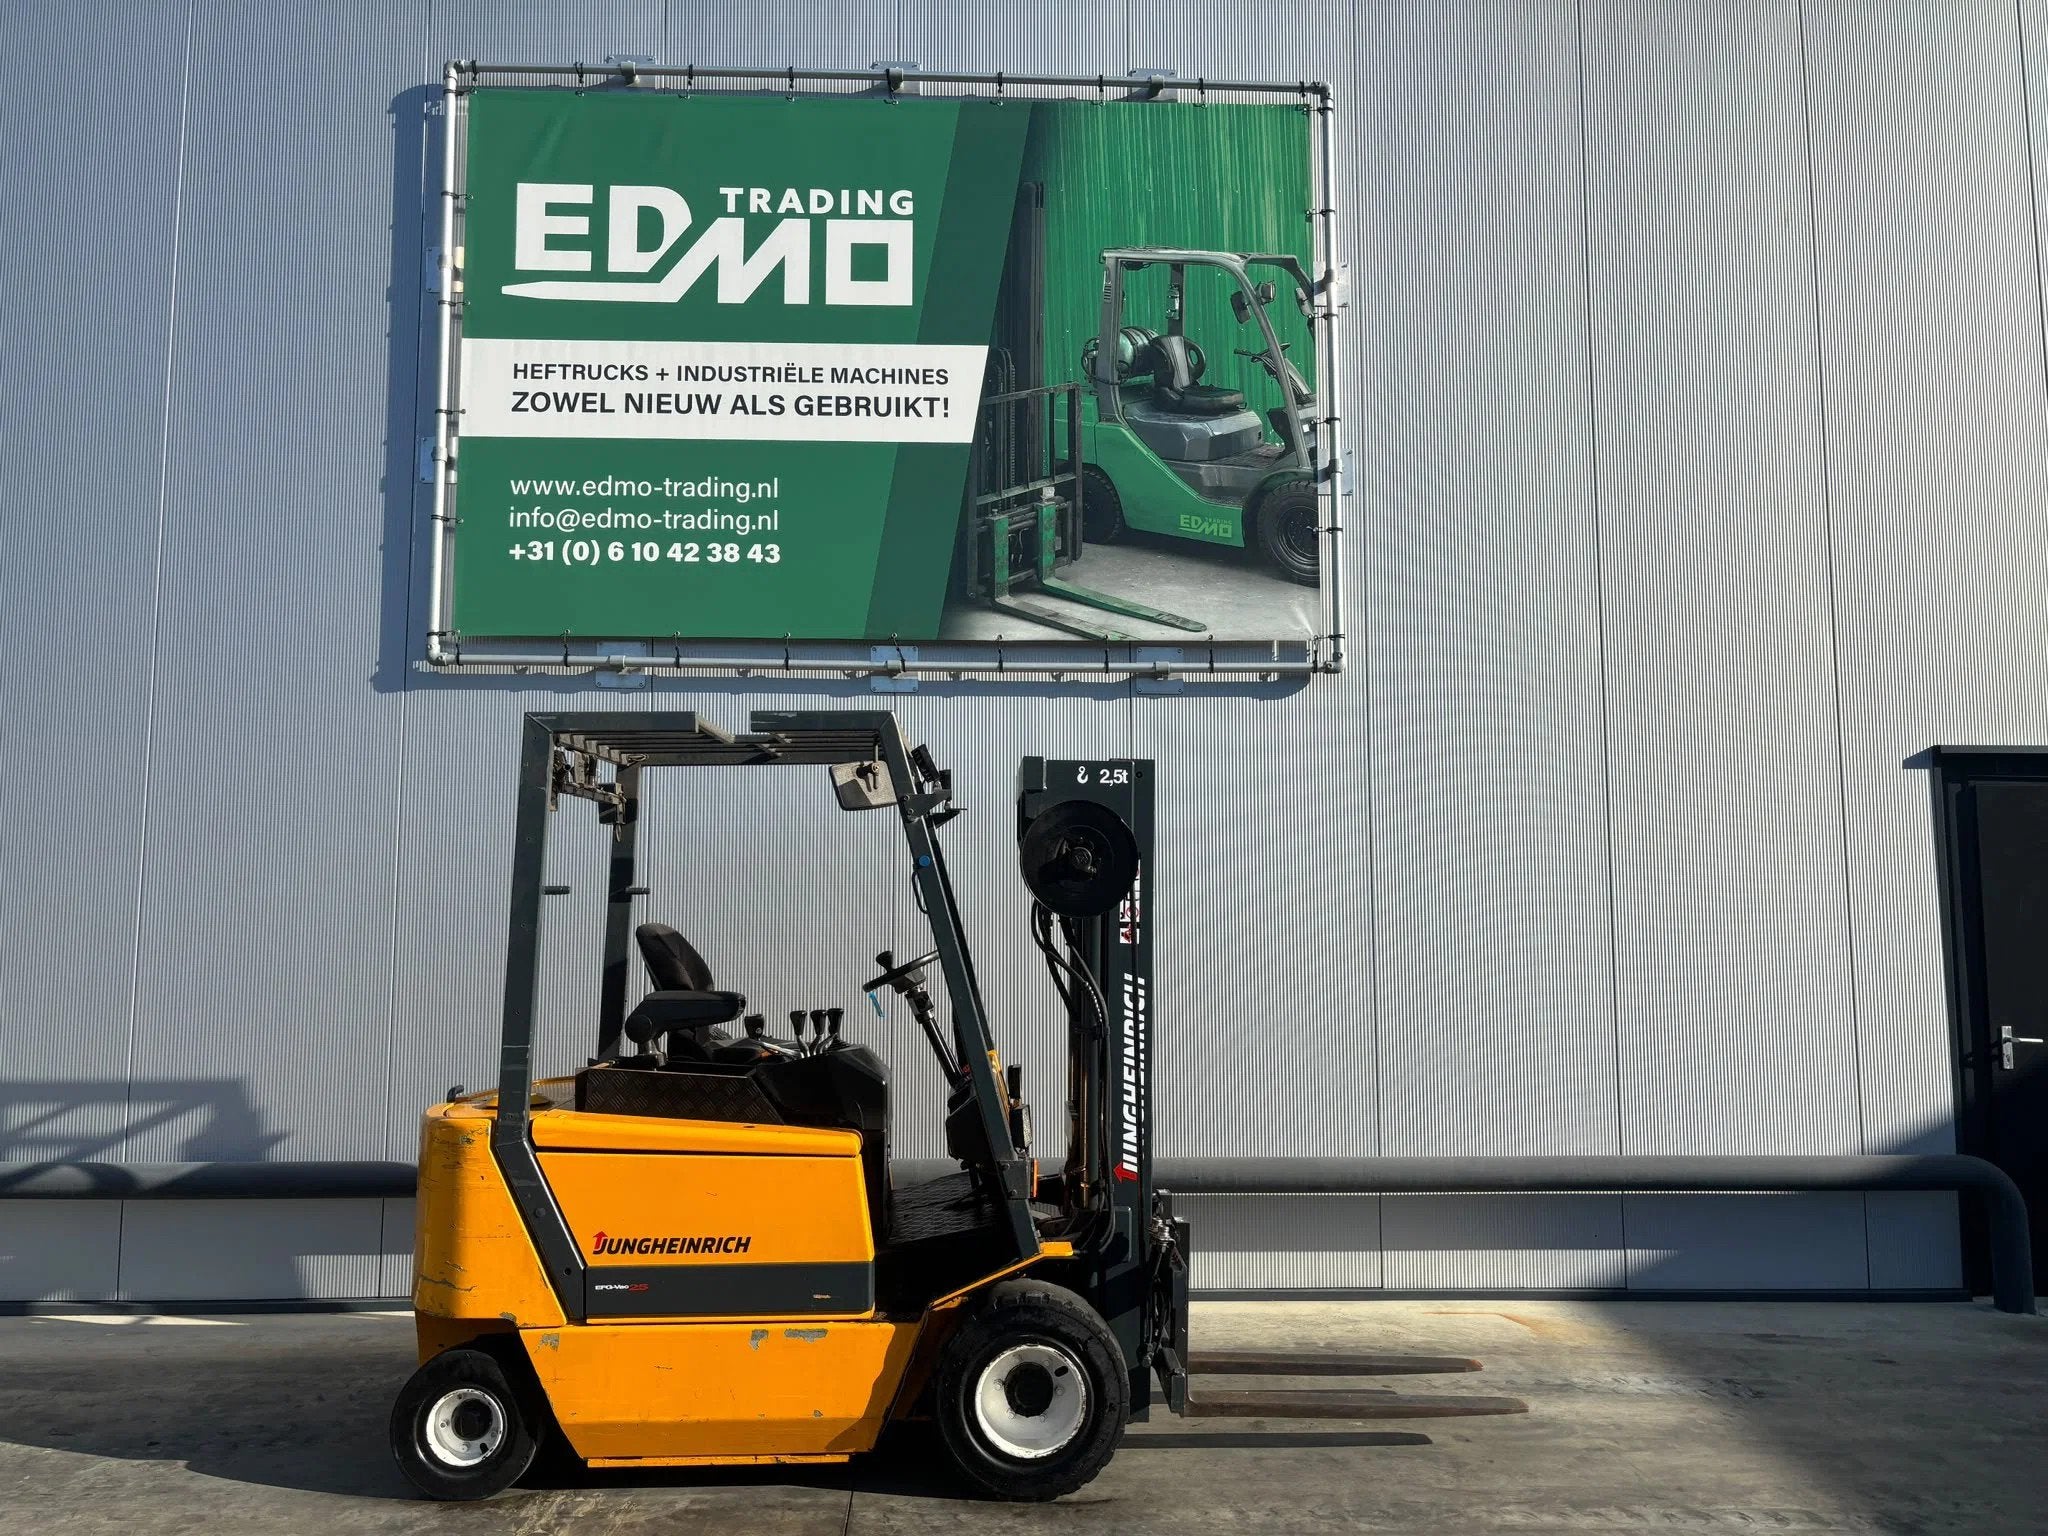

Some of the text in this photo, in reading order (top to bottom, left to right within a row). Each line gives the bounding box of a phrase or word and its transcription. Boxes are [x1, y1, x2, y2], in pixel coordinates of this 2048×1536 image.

[719, 187, 914, 216] TRADING
[502, 182, 914, 306] EDMO
[513, 362, 949, 386] HEFTRUCKS + INDUSTRIËLE MACHINES
[511, 391, 950, 418] ZOWEL NIEUW ALS GEBRUIKT!
[510, 475, 779, 503] www.edmo-trading.nl
[509, 507, 779, 535] info@edmo-trading.nl
[1179, 515, 1232, 538] EDMO
[509, 539, 781, 564] +31 (0) 6 10 42 38 43
[1099, 769, 1128, 786] 2,5t
[593, 1236, 752, 1255] JUNGHEINRICH
